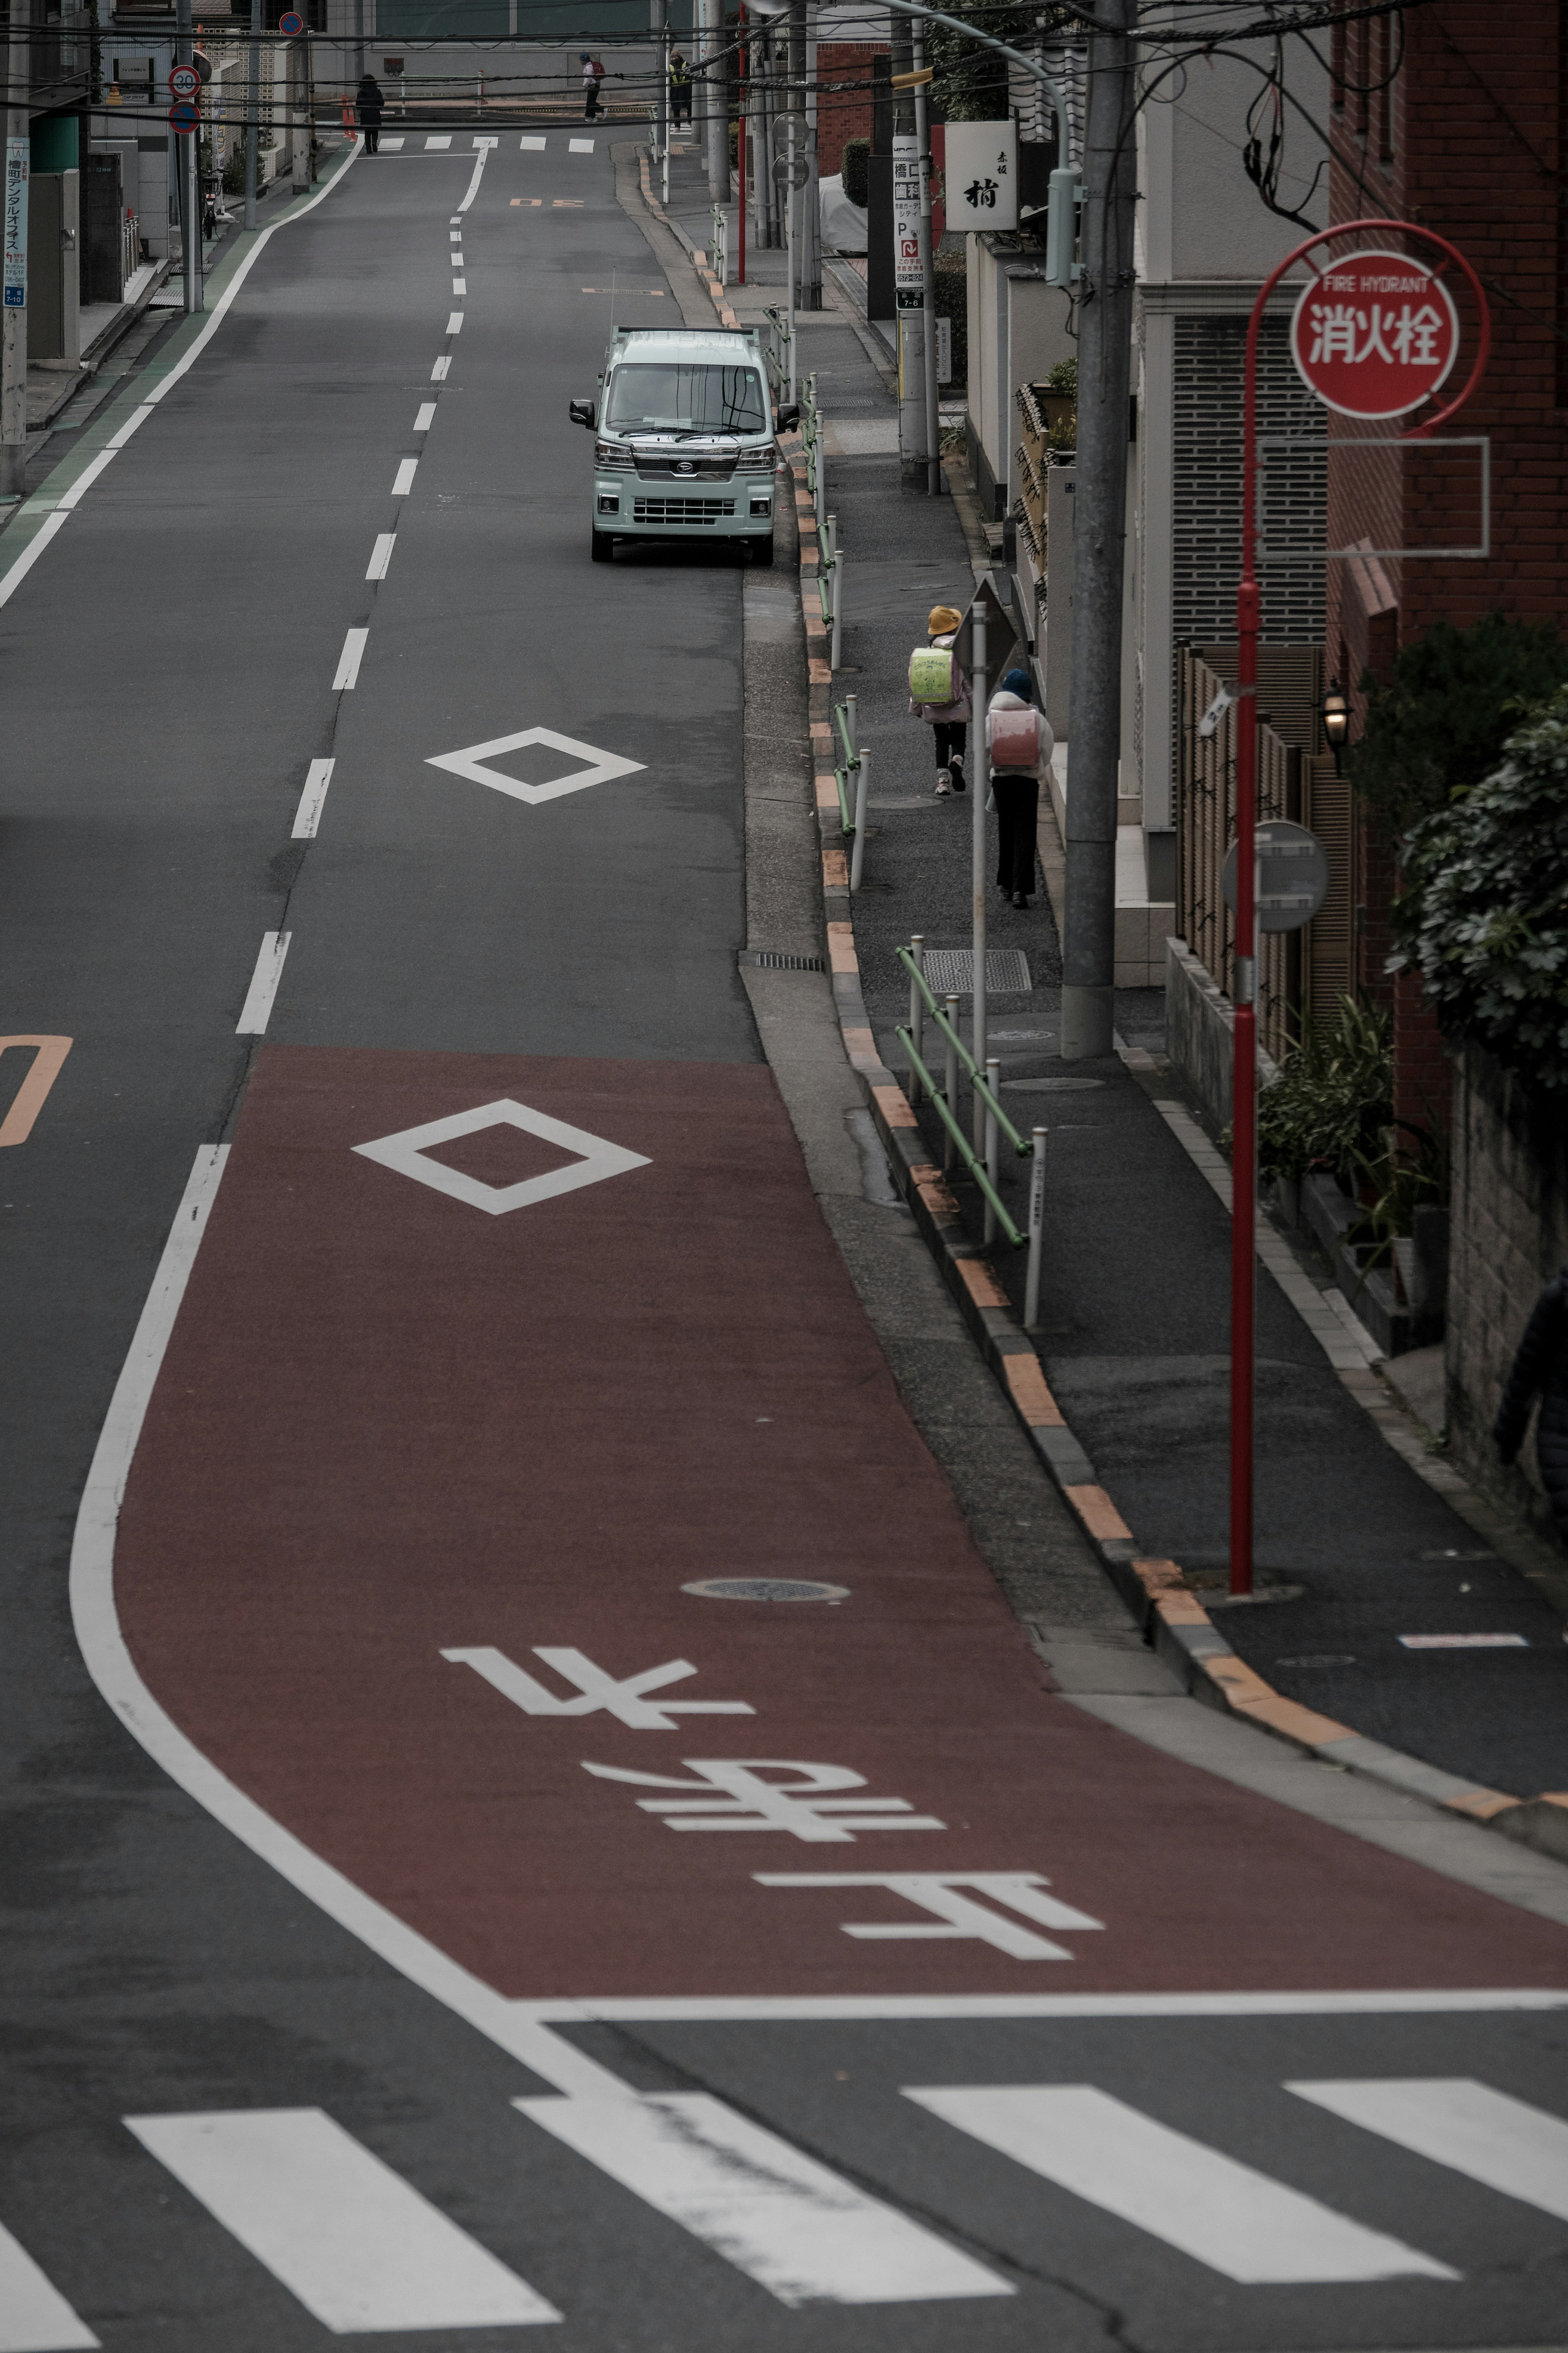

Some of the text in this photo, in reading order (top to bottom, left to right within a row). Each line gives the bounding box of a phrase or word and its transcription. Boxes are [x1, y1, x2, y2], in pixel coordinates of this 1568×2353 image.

[176, 75, 193, 89] 30
[895, 163, 919, 178] 橋口
[997, 152, 1007, 174] 赤坂
[895, 183, 920, 199] 歯科
[1323, 275, 1429, 293] FIRE HYDRANT
[1309, 303, 1443, 366] 消火栓
